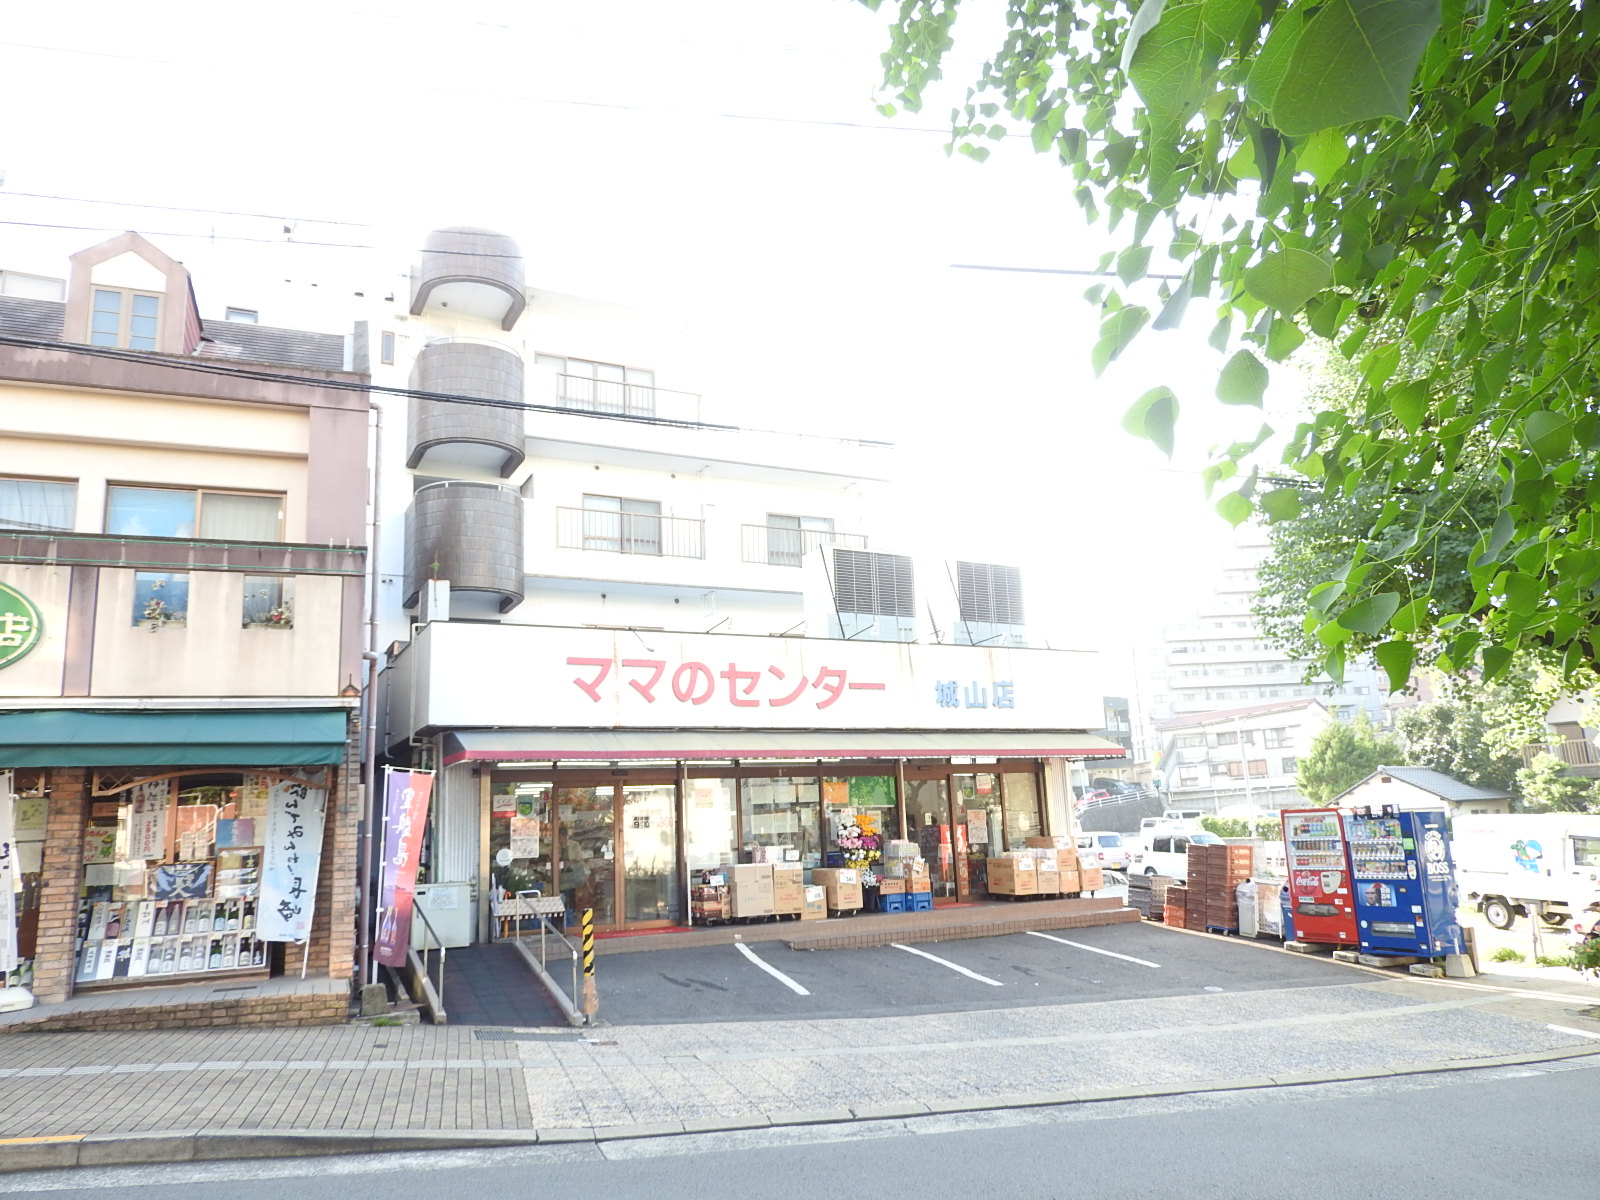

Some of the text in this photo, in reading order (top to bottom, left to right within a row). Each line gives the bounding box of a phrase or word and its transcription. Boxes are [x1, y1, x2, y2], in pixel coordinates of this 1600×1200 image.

[566, 656, 886, 709] ママのセンター
[935, 680, 1015, 709] 城山店
[1426, 861, 1450, 875] BOSS
[1295, 875, 1320, 886] Coca-Cola
